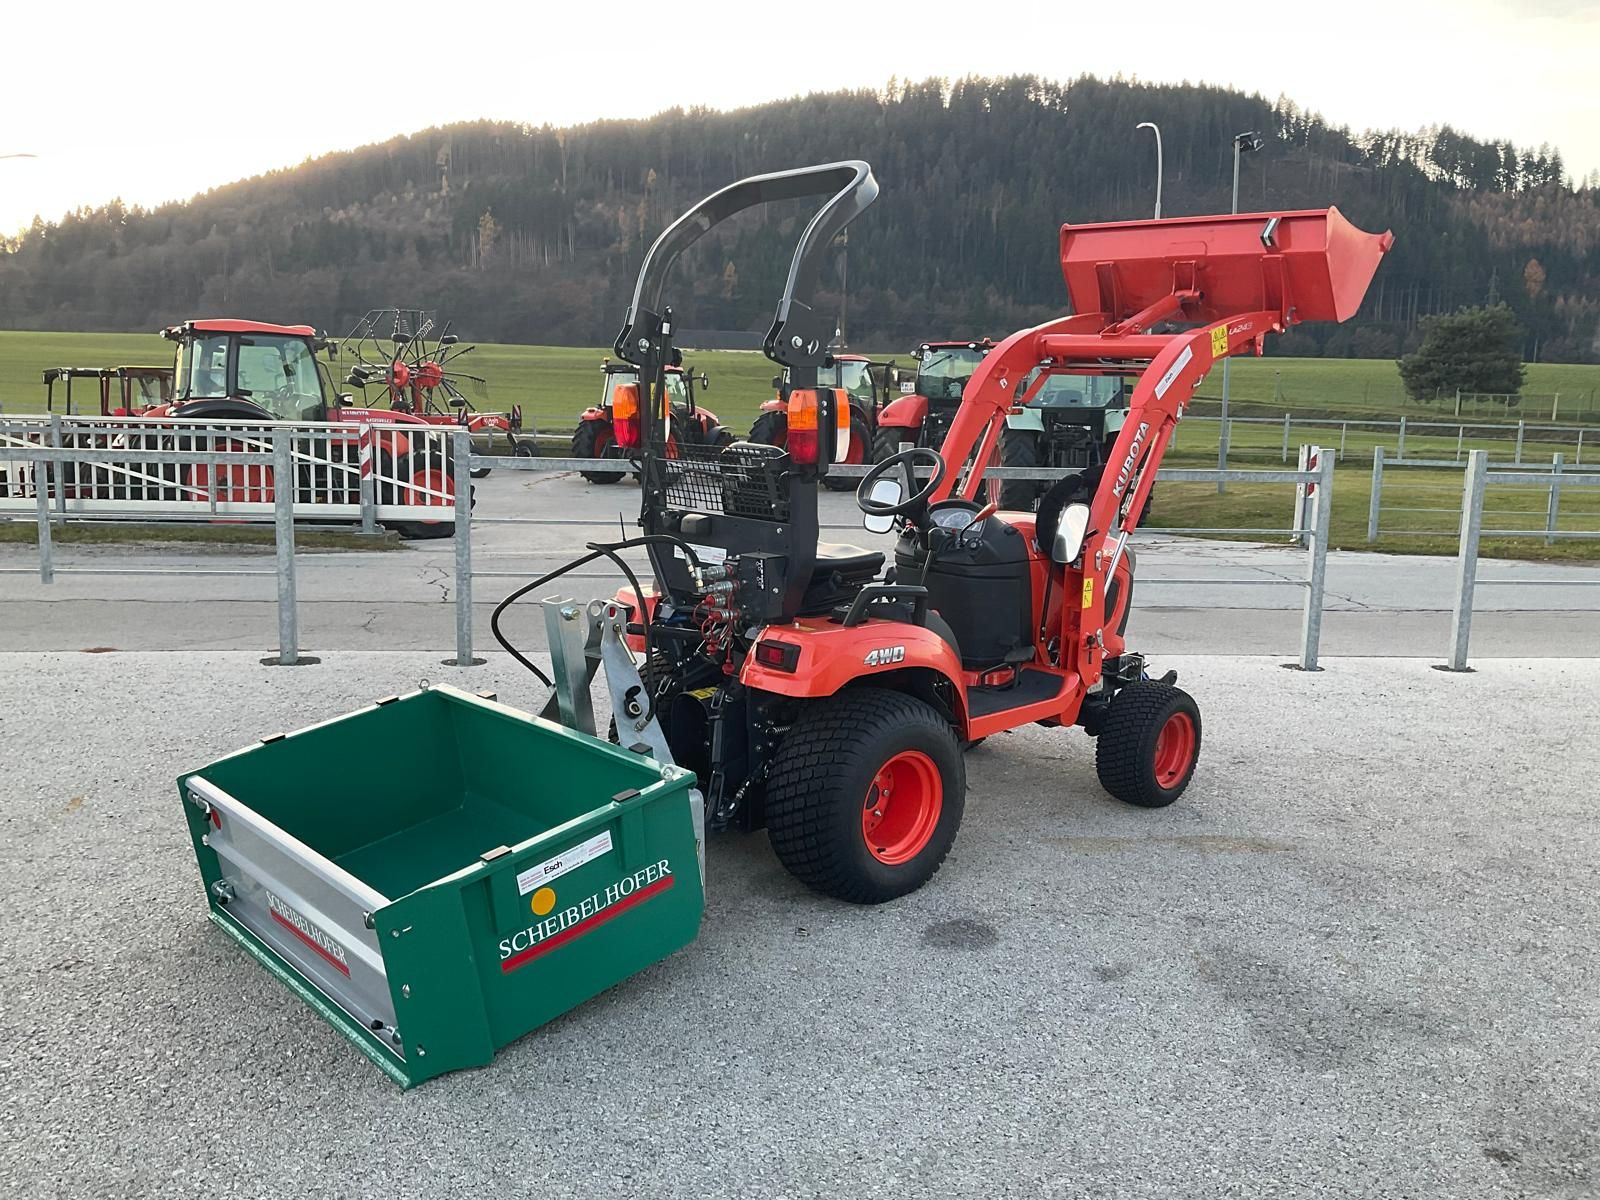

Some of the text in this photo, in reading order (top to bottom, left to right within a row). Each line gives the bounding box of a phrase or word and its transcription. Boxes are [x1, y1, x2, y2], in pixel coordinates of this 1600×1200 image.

[1112, 422, 1150, 498] KUBOTA
[863, 645, 905, 666] 4WD
[543, 860, 563, 875] Esch
[265, 890, 348, 966] SCHEIBELHOFER
[499, 859, 672, 960] SCHEIBELHOFER
